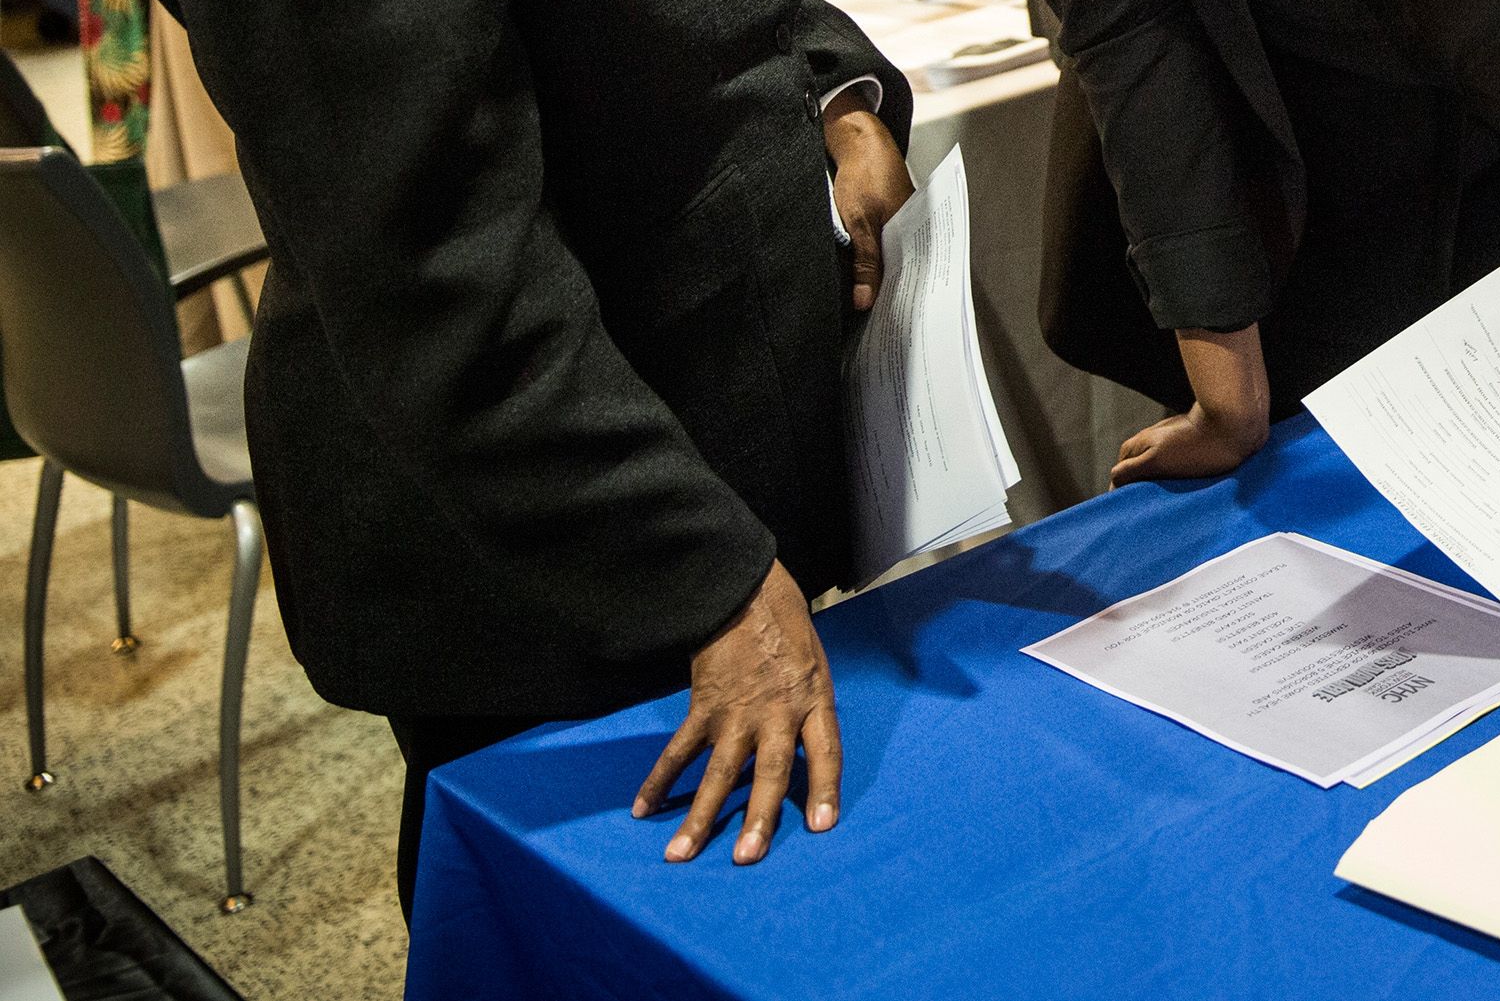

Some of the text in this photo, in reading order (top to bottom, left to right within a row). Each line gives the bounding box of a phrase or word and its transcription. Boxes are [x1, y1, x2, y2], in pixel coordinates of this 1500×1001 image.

[1254, 562, 1290, 578] PLEASE
[1186, 574, 1250, 603] APPOINTMENT
[1218, 576, 1261, 596] CONTACT
[1191, 594, 1224, 609] CRAIG
[1214, 589, 1258, 609] MEDICAL
[1232, 591, 1276, 611] TRANSIT
[1137, 612, 1186, 634] MONIQUE
[1211, 609, 1238, 621] CARD
[1232, 610, 1258, 623] SICK
[1256, 610, 1282, 622] 401K
[1410, 617, 1438, 631] NYHC
[1243, 615, 1295, 640] EXCELLENT
[1278, 624, 1322, 646] WEEKEND
[1282, 620, 1307, 632] LIVE
[1297, 622, 1350, 648] IMMEDIATE
[1384, 620, 1415, 636] AIDES
[1100, 640, 1125, 651] YOU
[1120, 631, 1143, 642] FOR
[1363, 634, 1407, 655] LOOKING
[1312, 633, 1374, 665] WESTCHESTER
[1338, 640, 1377, 660] SERVICE
[1346, 653, 1370, 664] FOR
[1320, 657, 1344, 669] THE
[1268, 669, 1319, 696] BOROUGHS
[1303, 661, 1353, 687] CERTIFIED
[1305, 645, 1423, 704] JOBS AVAILABLE
[1365, 670, 1414, 696] NEW YORK
[1249, 692, 1274, 705] AND
[1278, 683, 1310, 700] HOME
[1377, 674, 1437, 705] NYHC
[1243, 696, 1284, 718] HEALTH
